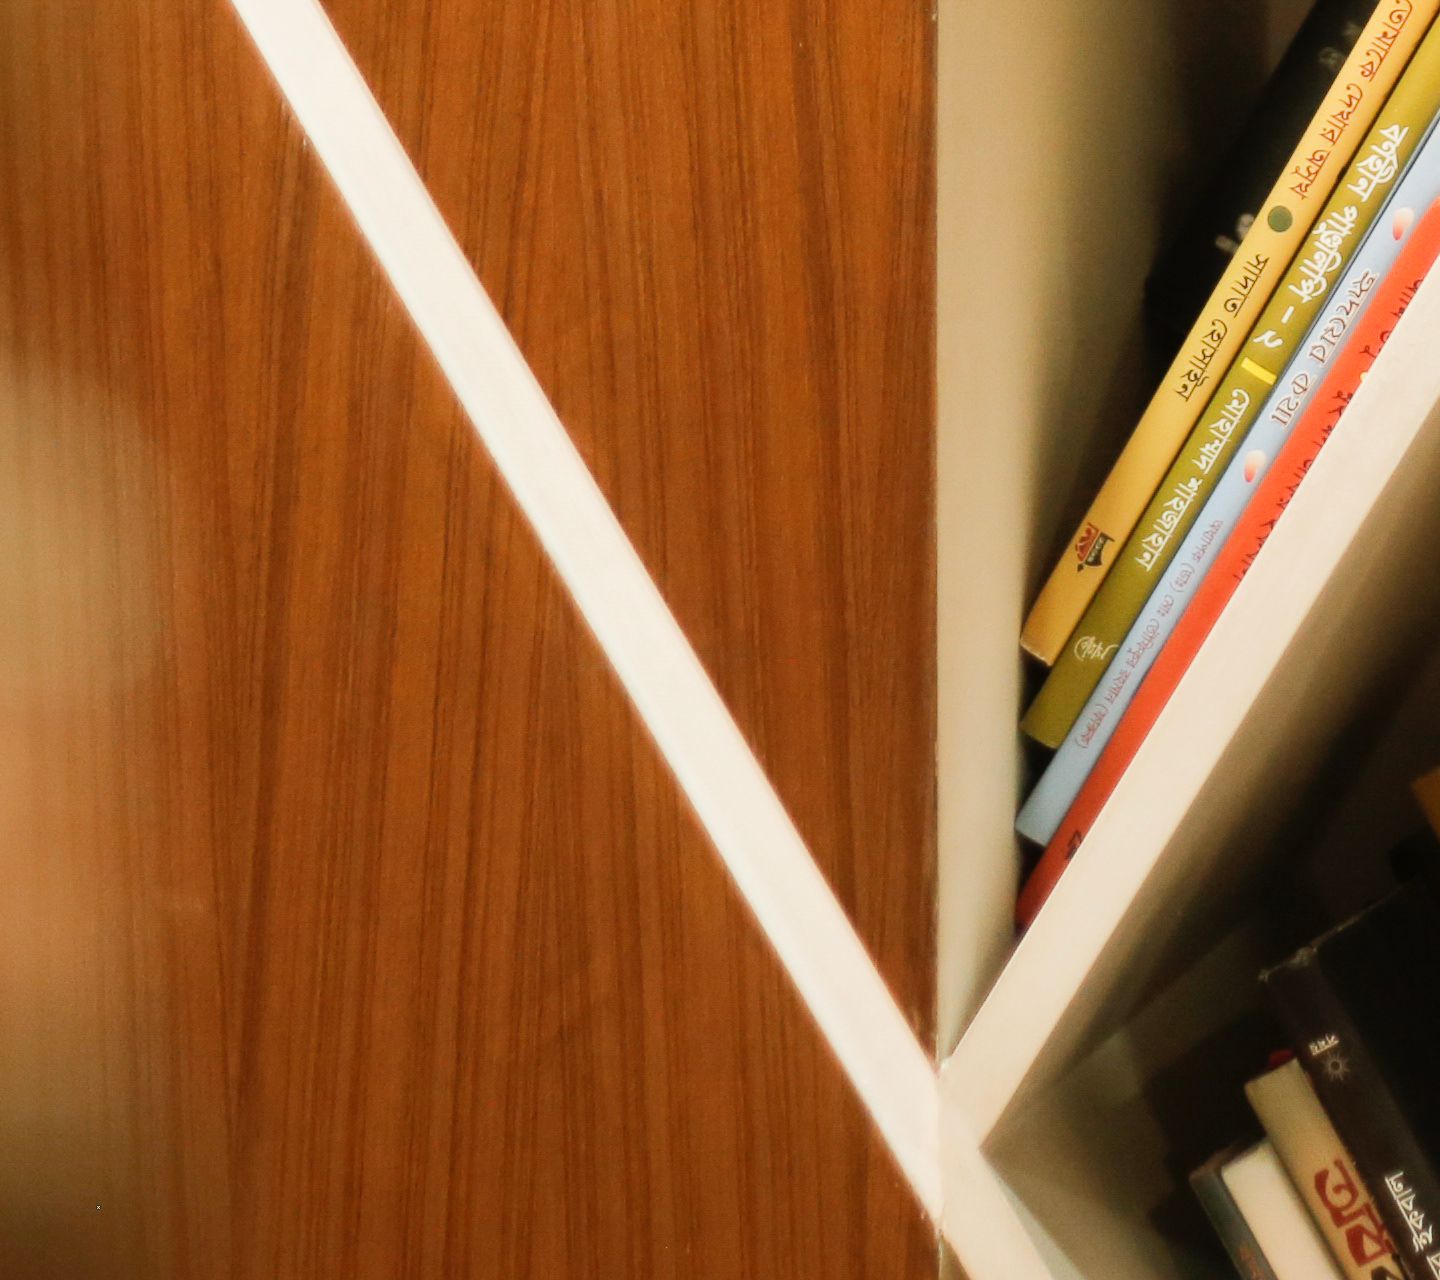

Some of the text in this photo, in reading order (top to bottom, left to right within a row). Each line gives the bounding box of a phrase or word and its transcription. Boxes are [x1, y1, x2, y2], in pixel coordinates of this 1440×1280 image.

[1320, 84, 1363, 146] দেখার
[1290, 150, 1331, 200] অসুখ
[1348, 125, 1408, 202] বর্ণহীন
[1224, 254, 1269, 319] সাদাত
[1309, 266, 1379, 368] হৃদয়ের
[1175, 319, 1227, 402] হোসাইন
[1253, 331, 1282, 348] ২
[1268, 366, 1318, 433] কথা
[1136, 389, 1249, 570] মোহাম্মদ শাহজাহান
[1187, 515, 1227, 564] অধ্যাপক
[1154, 592, 1177, 619] মোঃ
[1100, 667, 1134, 706] রহমান
[1385, 1172, 1432, 1252] ইকবাল
